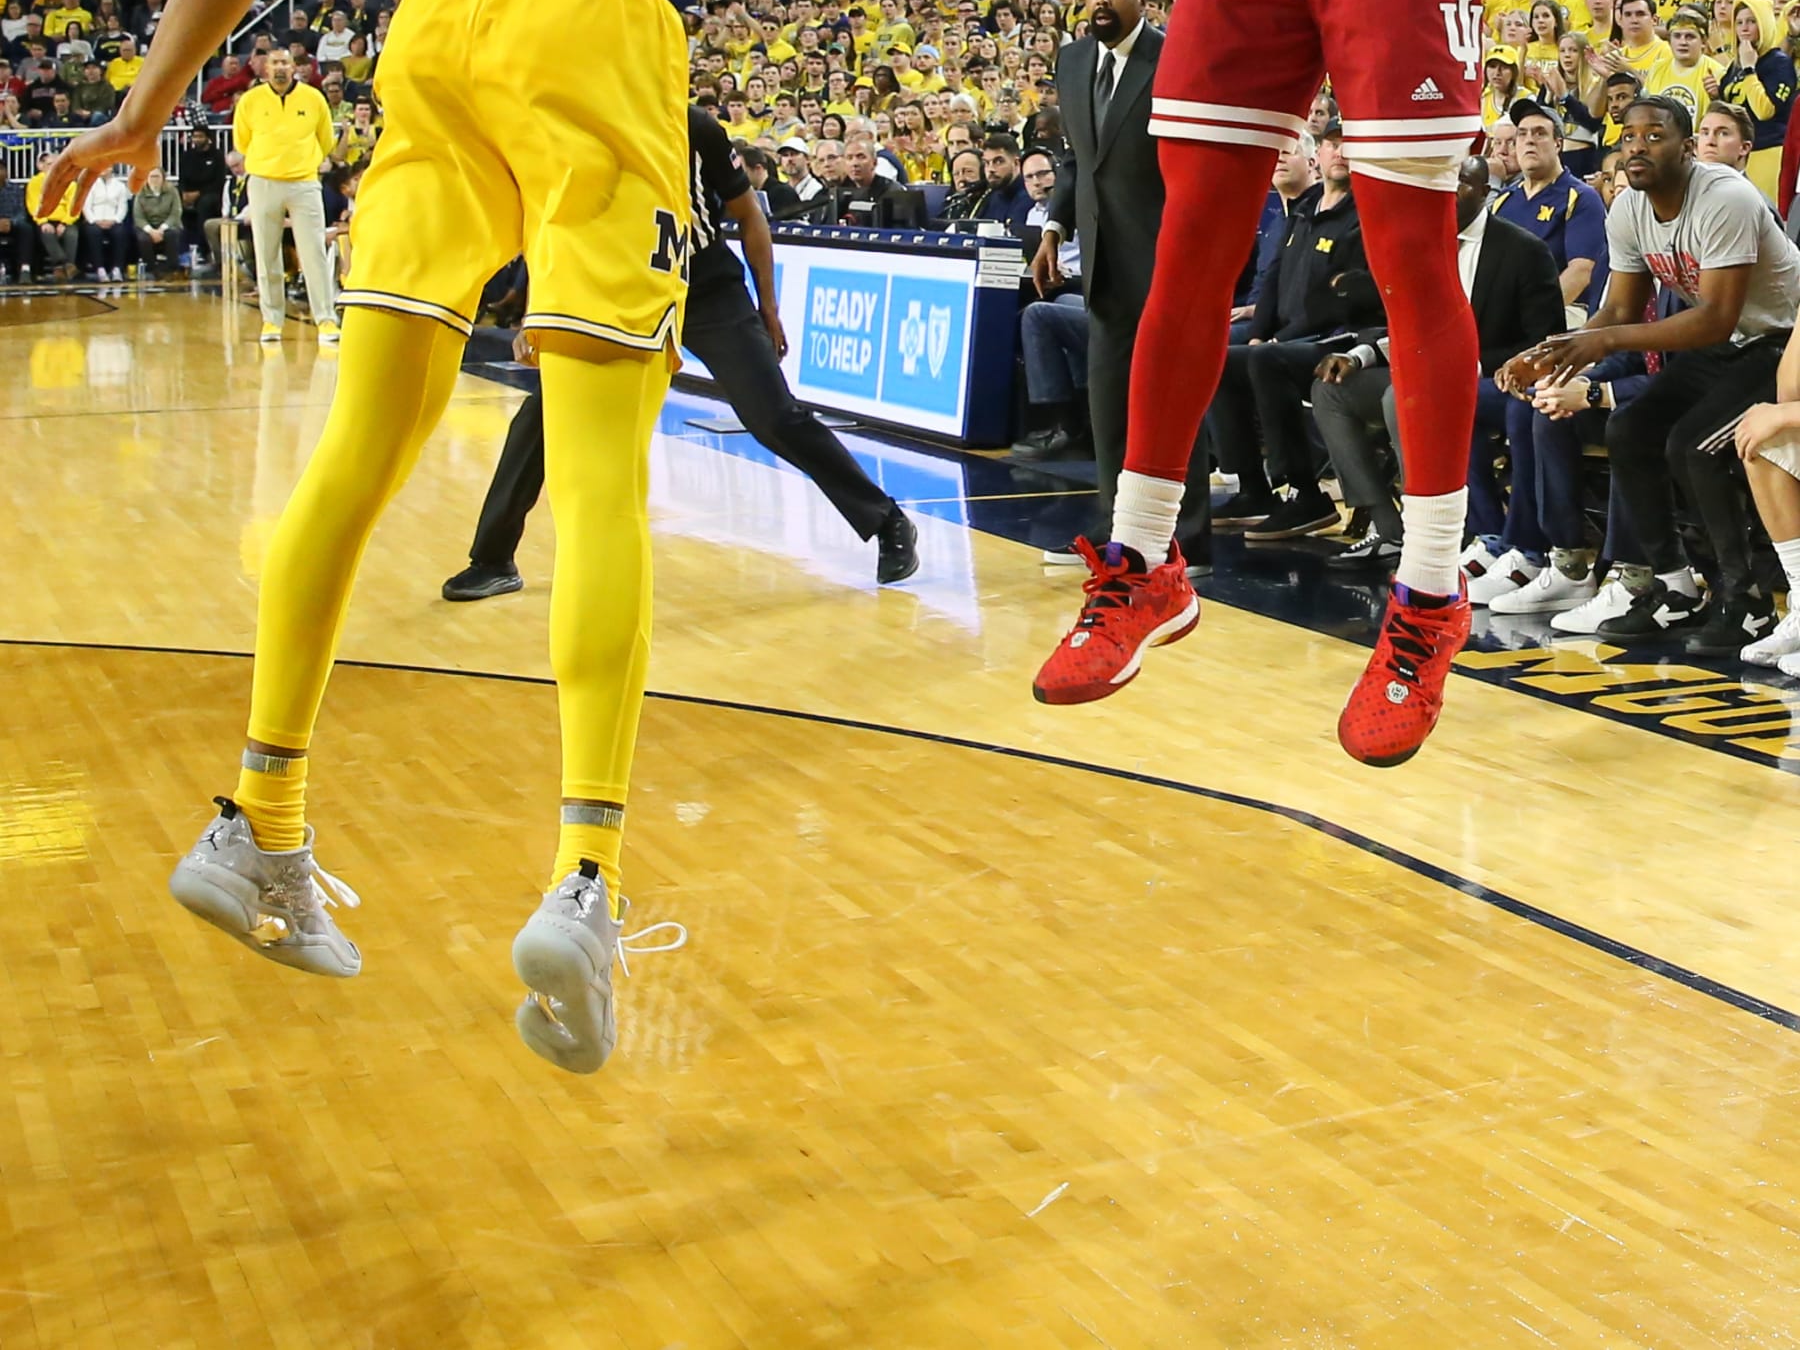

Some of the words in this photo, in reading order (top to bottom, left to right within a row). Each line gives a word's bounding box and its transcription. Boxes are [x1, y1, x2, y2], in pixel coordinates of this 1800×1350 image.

[1410, 91, 1445, 101] adidas
[649, 206, 691, 288] M
[811, 286, 878, 334] READY
[810, 332, 830, 369] TO
[829, 334, 873, 376] HELP
